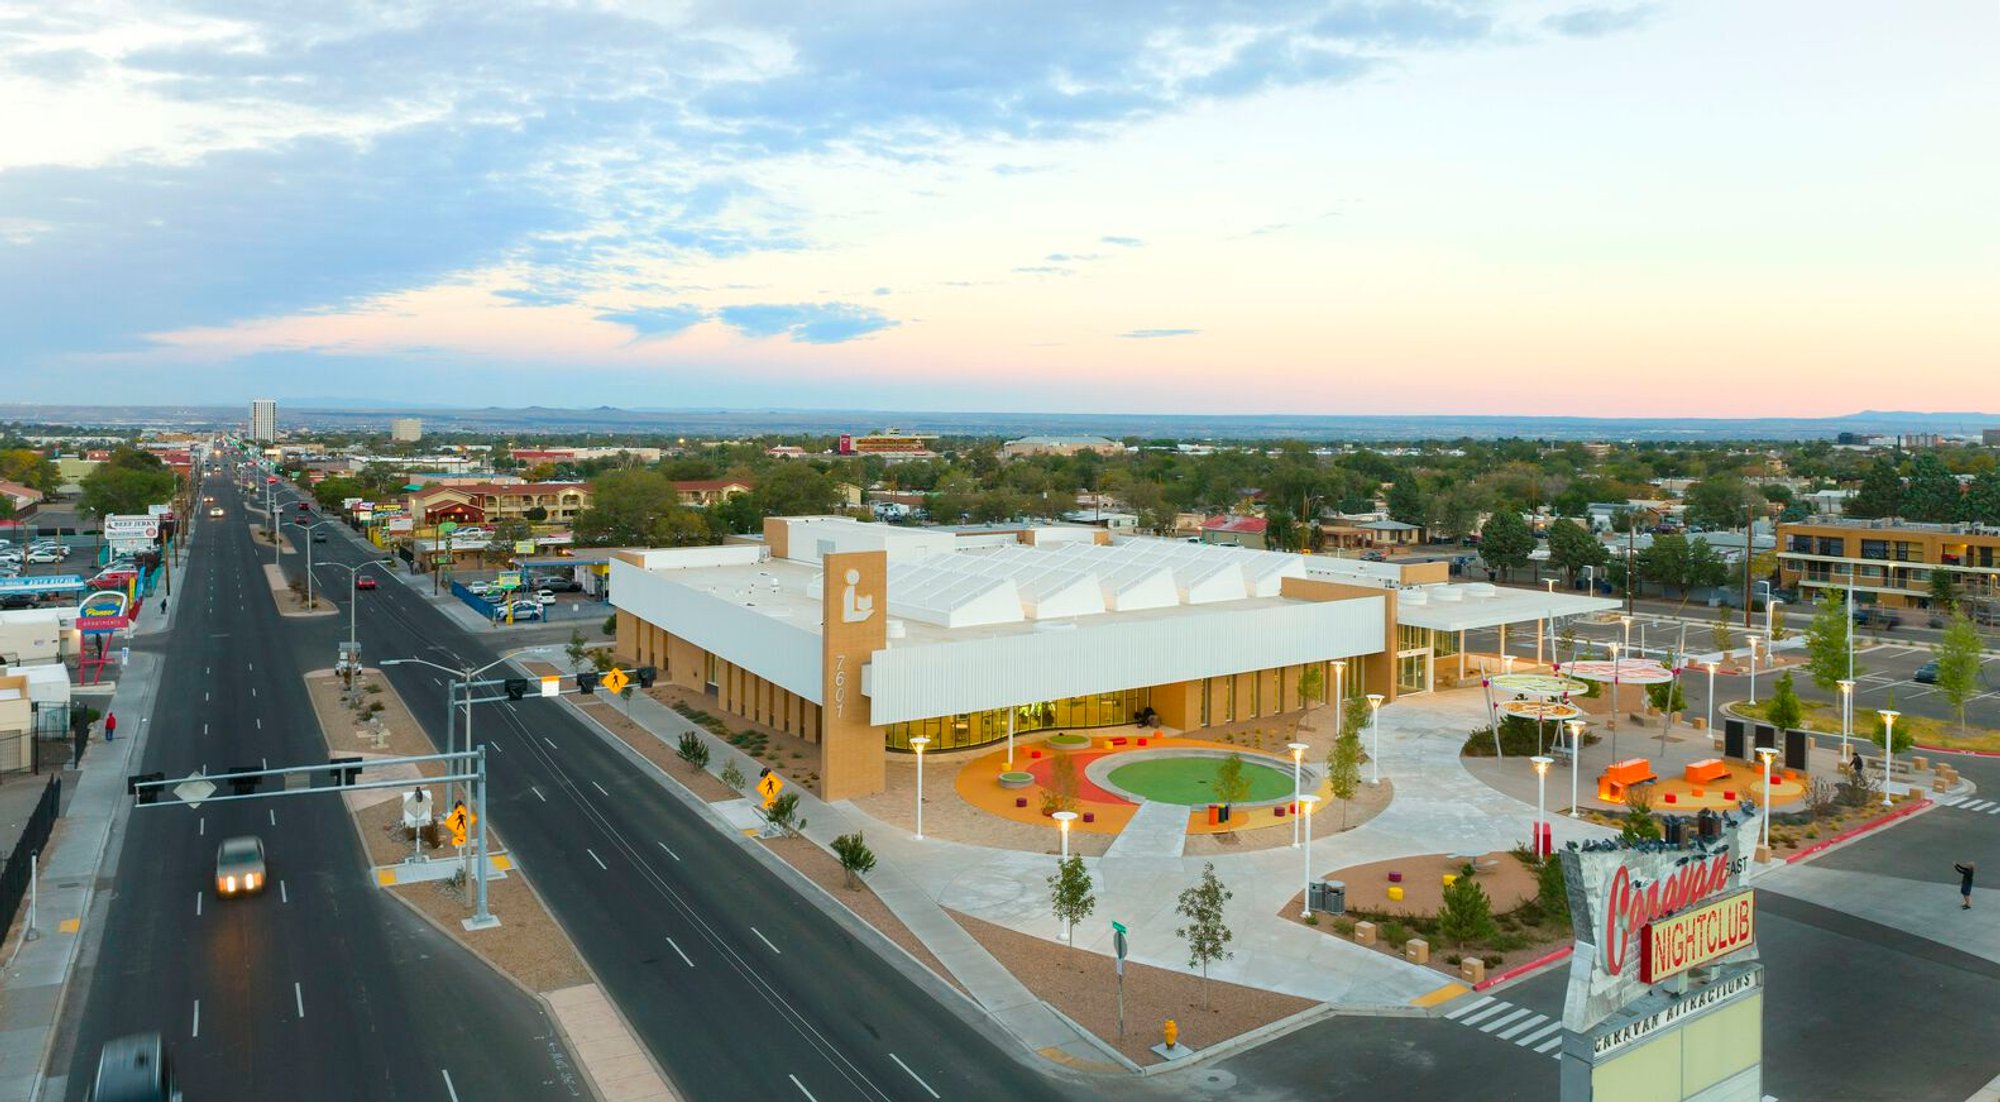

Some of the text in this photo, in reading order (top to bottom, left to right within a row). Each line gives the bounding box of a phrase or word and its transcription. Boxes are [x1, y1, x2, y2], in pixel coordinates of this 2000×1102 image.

[834, 654, 846, 719] 7601
[1606, 852, 1729, 976] Caravan
[1654, 899, 1750, 975] NIGHTCLUB
[1594, 1012, 1660, 1053] CARAVAN
